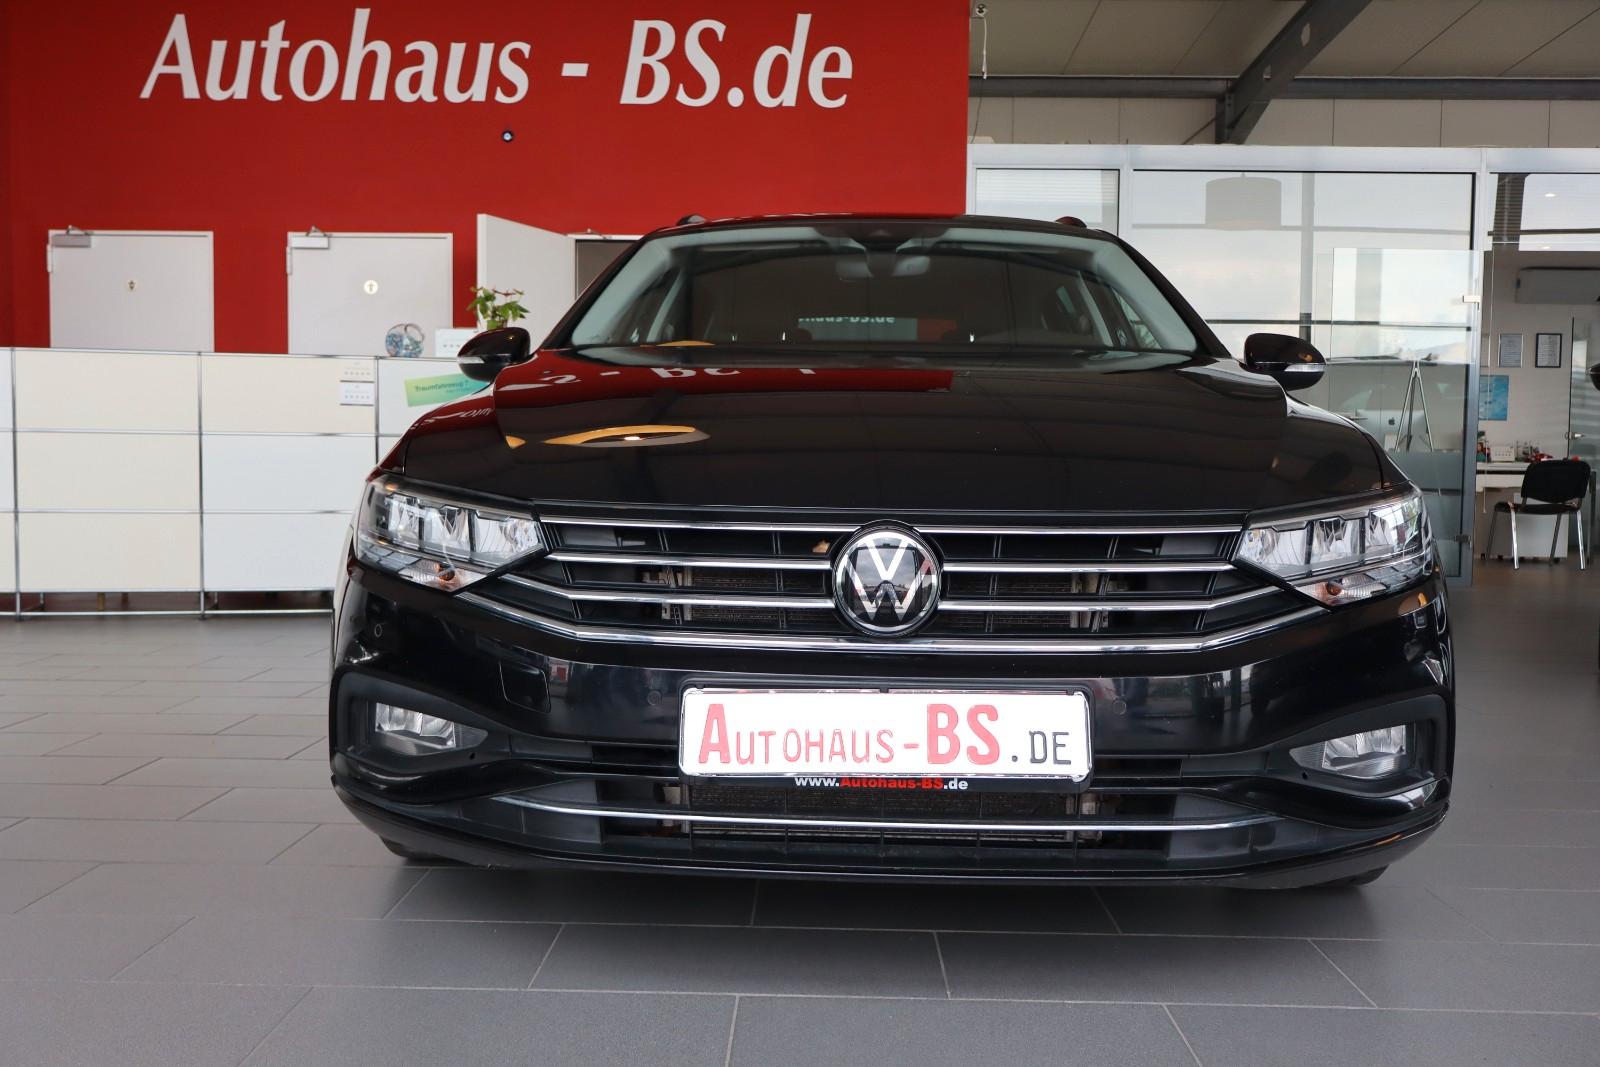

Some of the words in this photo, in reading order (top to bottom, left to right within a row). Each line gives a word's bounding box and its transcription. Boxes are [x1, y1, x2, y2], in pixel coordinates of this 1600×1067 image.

[140, 7, 531, 104] Autohaus
[620, 13, 853, 109] BS.de
[794, 777, 969, 790] www.Autohaus-BS.de
